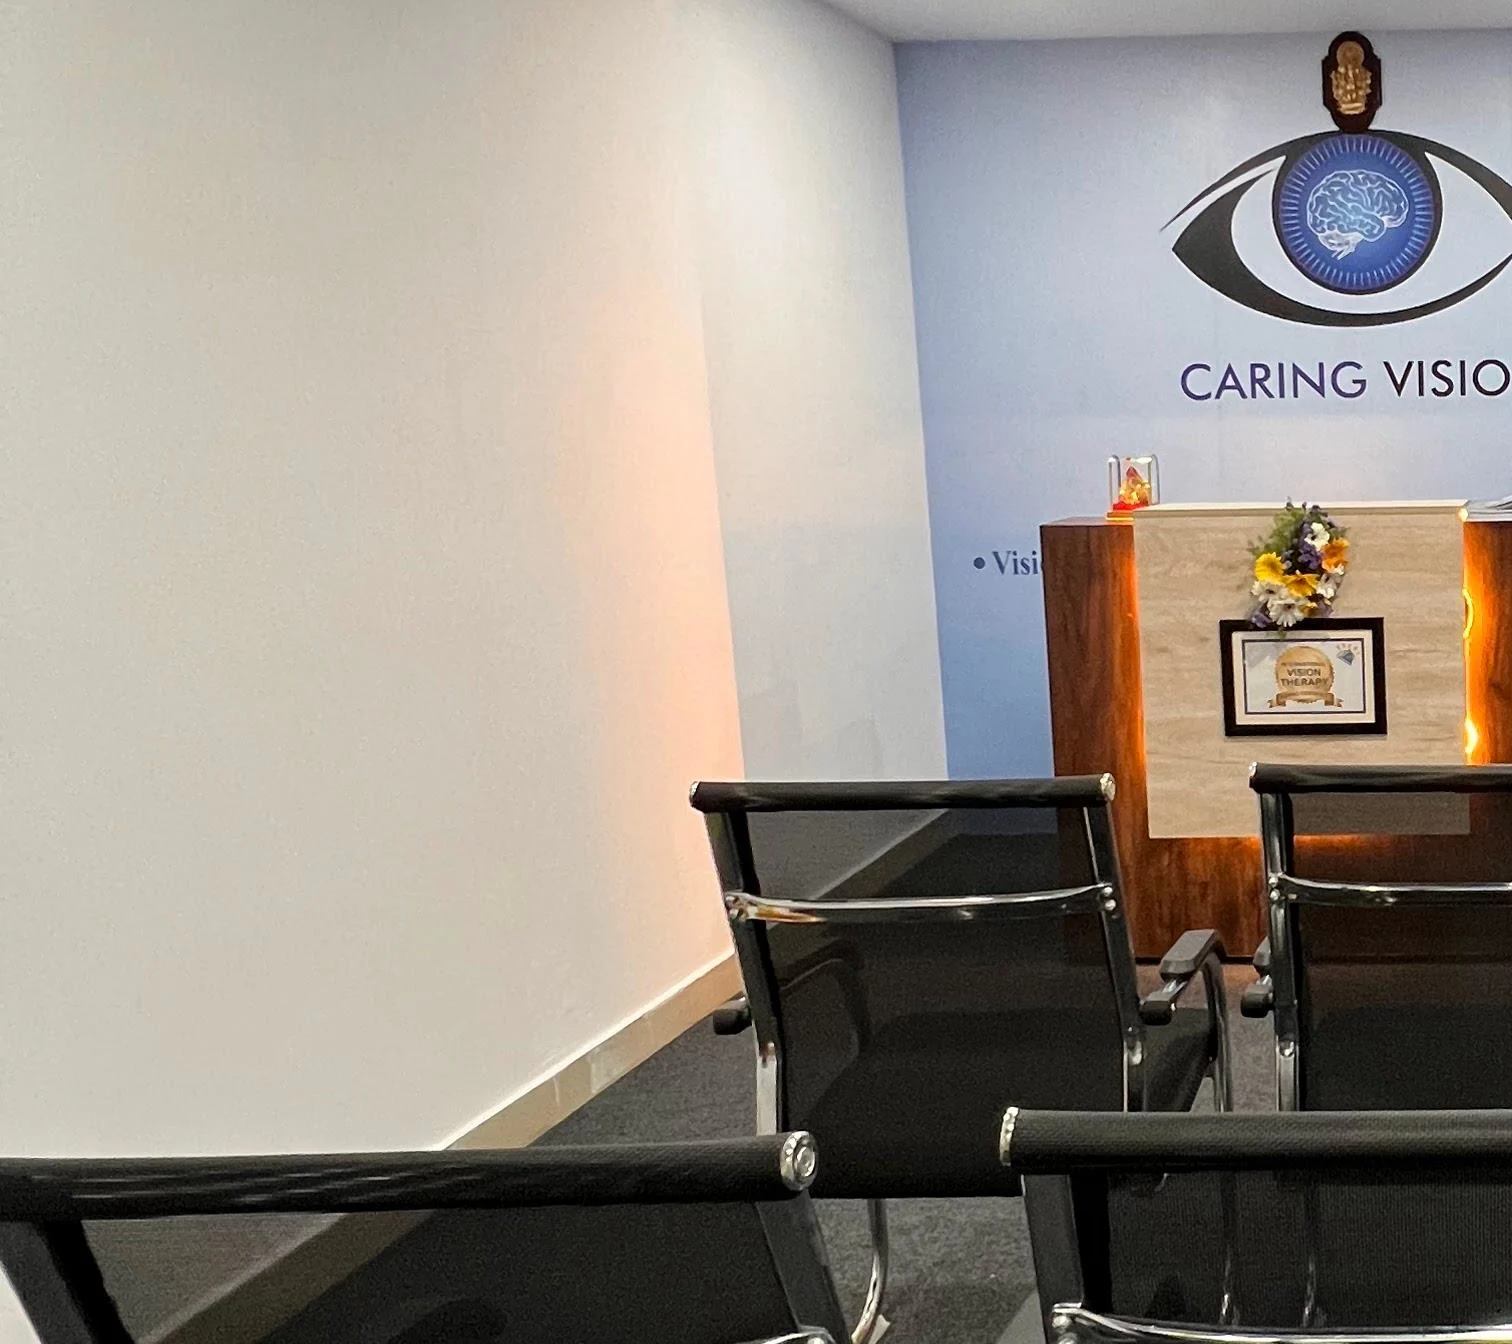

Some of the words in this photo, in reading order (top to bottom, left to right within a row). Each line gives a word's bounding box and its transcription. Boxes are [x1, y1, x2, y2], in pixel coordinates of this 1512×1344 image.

[1180, 360, 1367, 401] CARING
[991, 549, 1039, 575] Visi
[1287, 668, 1321, 677] VISION
[1280, 677, 1330, 686] THERAPY
